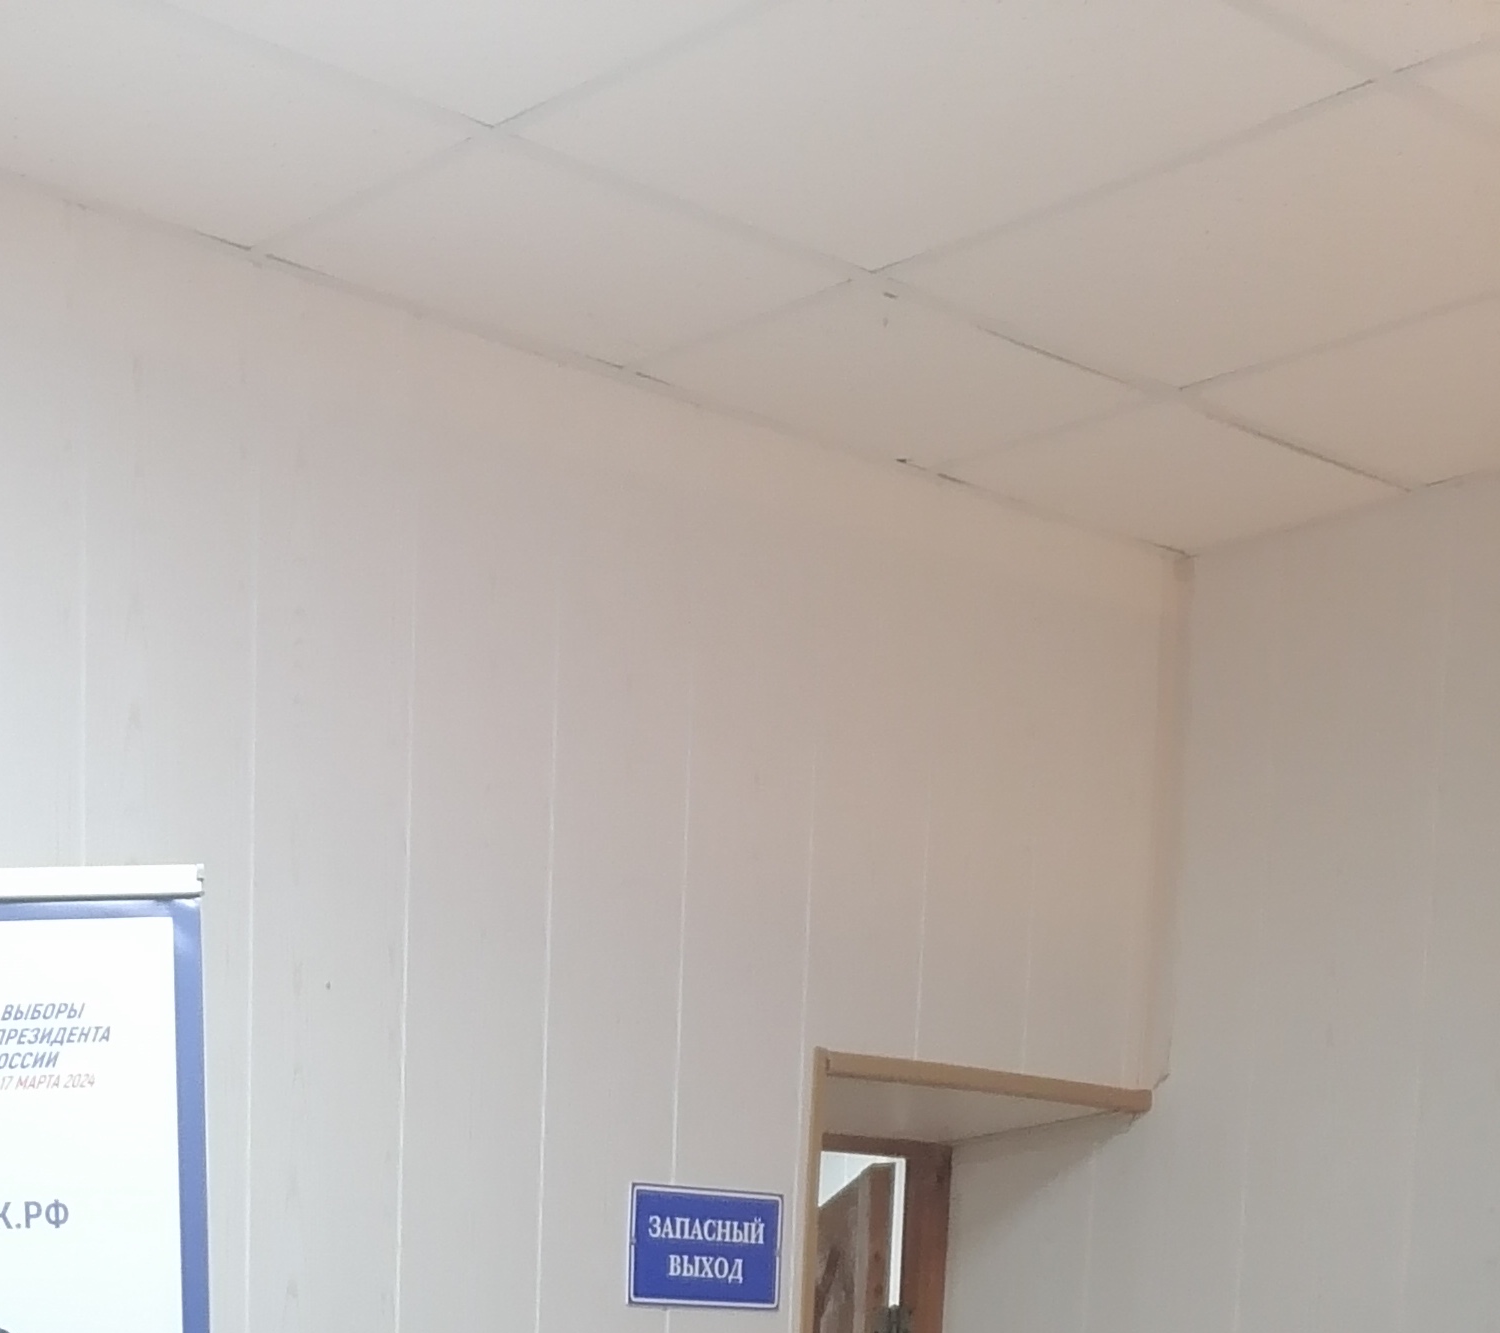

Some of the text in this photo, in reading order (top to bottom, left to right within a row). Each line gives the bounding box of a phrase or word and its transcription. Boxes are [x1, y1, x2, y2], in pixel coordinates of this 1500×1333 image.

[0, 1002, 85, 1021] ВЫБОРЫ
[15, 1075, 60, 1090] МАРТА
[63, 1073, 95, 1089] 2024
[648, 1215, 765, 1245] ЗАПАСНЫЙ
[668, 1254, 744, 1284] ВЫХОД
